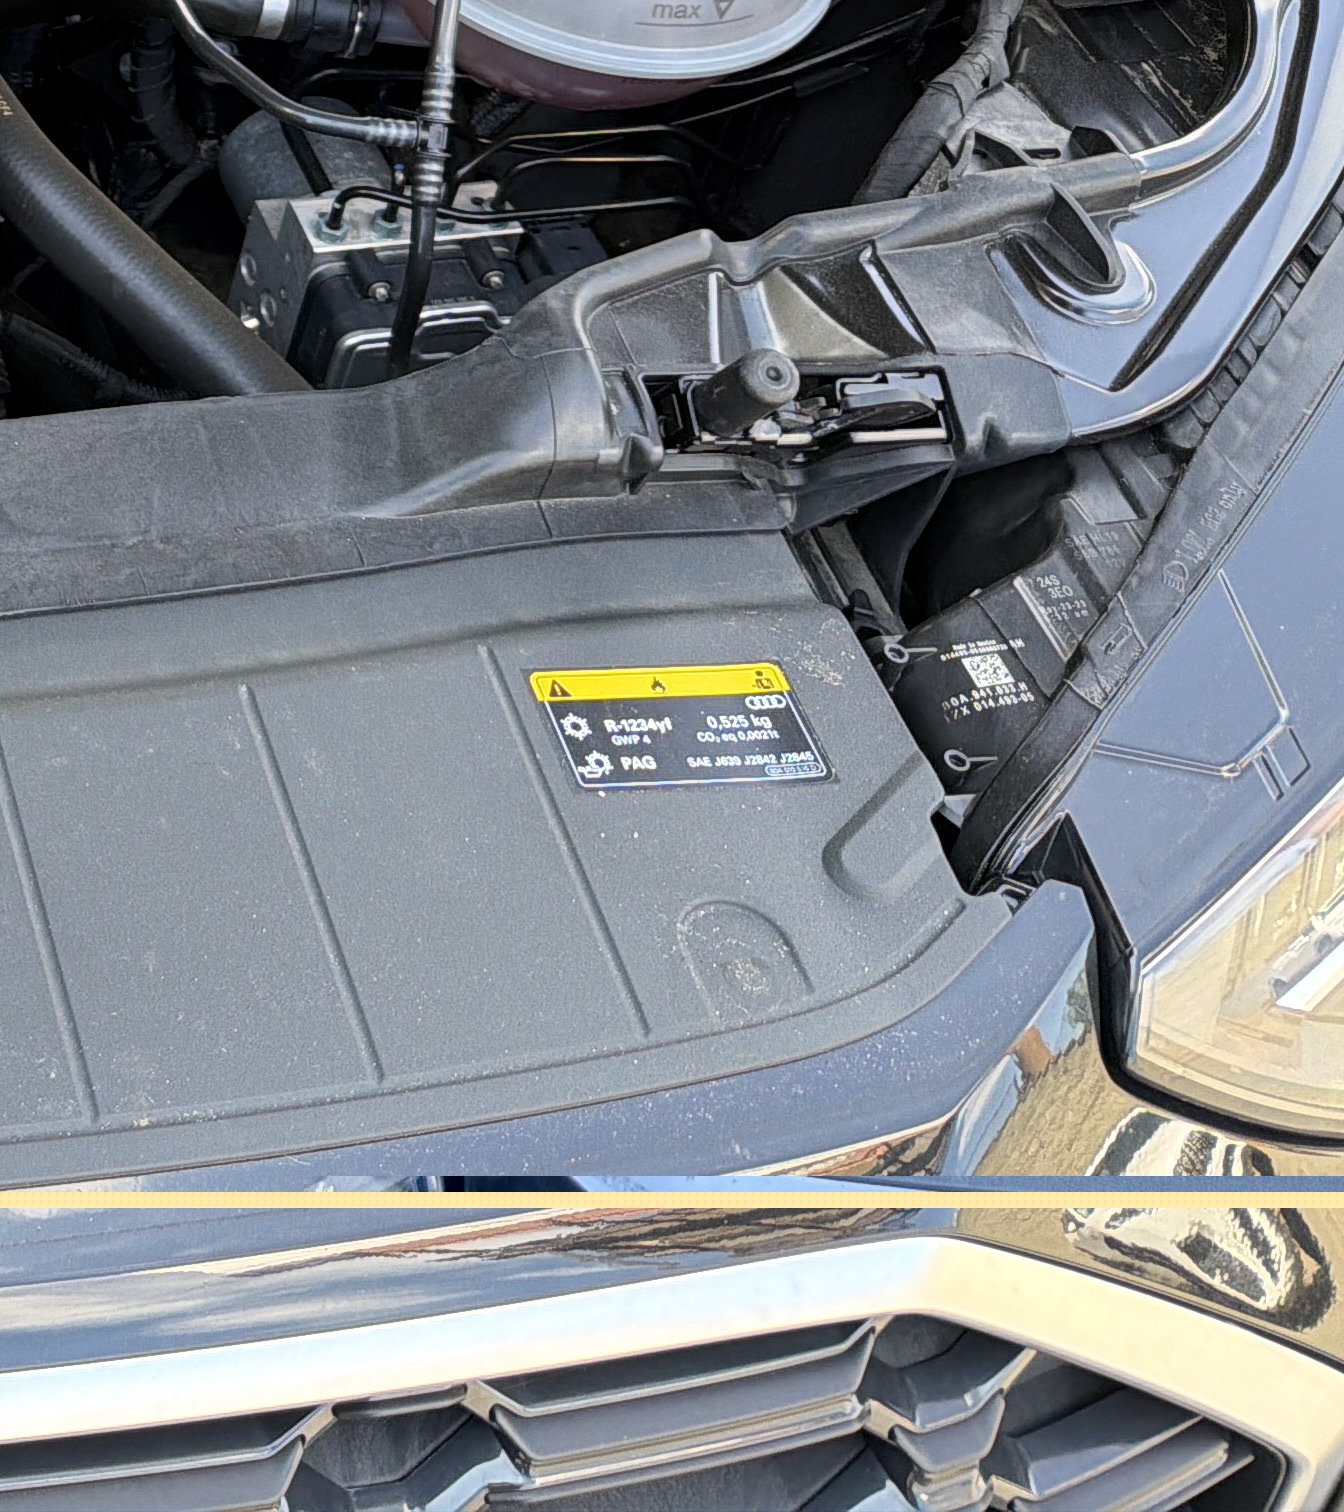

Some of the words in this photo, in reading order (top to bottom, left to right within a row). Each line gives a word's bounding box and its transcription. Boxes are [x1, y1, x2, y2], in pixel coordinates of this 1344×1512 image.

[651, 1, 703, 20] max
[603, 716, 673, 734] R-1234yf
[706, 714, 749, 731] 0,525
[750, 713, 772, 729] kg
[611, 734, 640, 746] GWP
[642, 734, 652, 744] 4
[620, 755, 657, 770] PAG
[686, 756, 713, 768] SAE
[714, 755, 742, 767] J639
[744, 753, 778, 766] J2842
[780, 750, 815, 764] J2845
